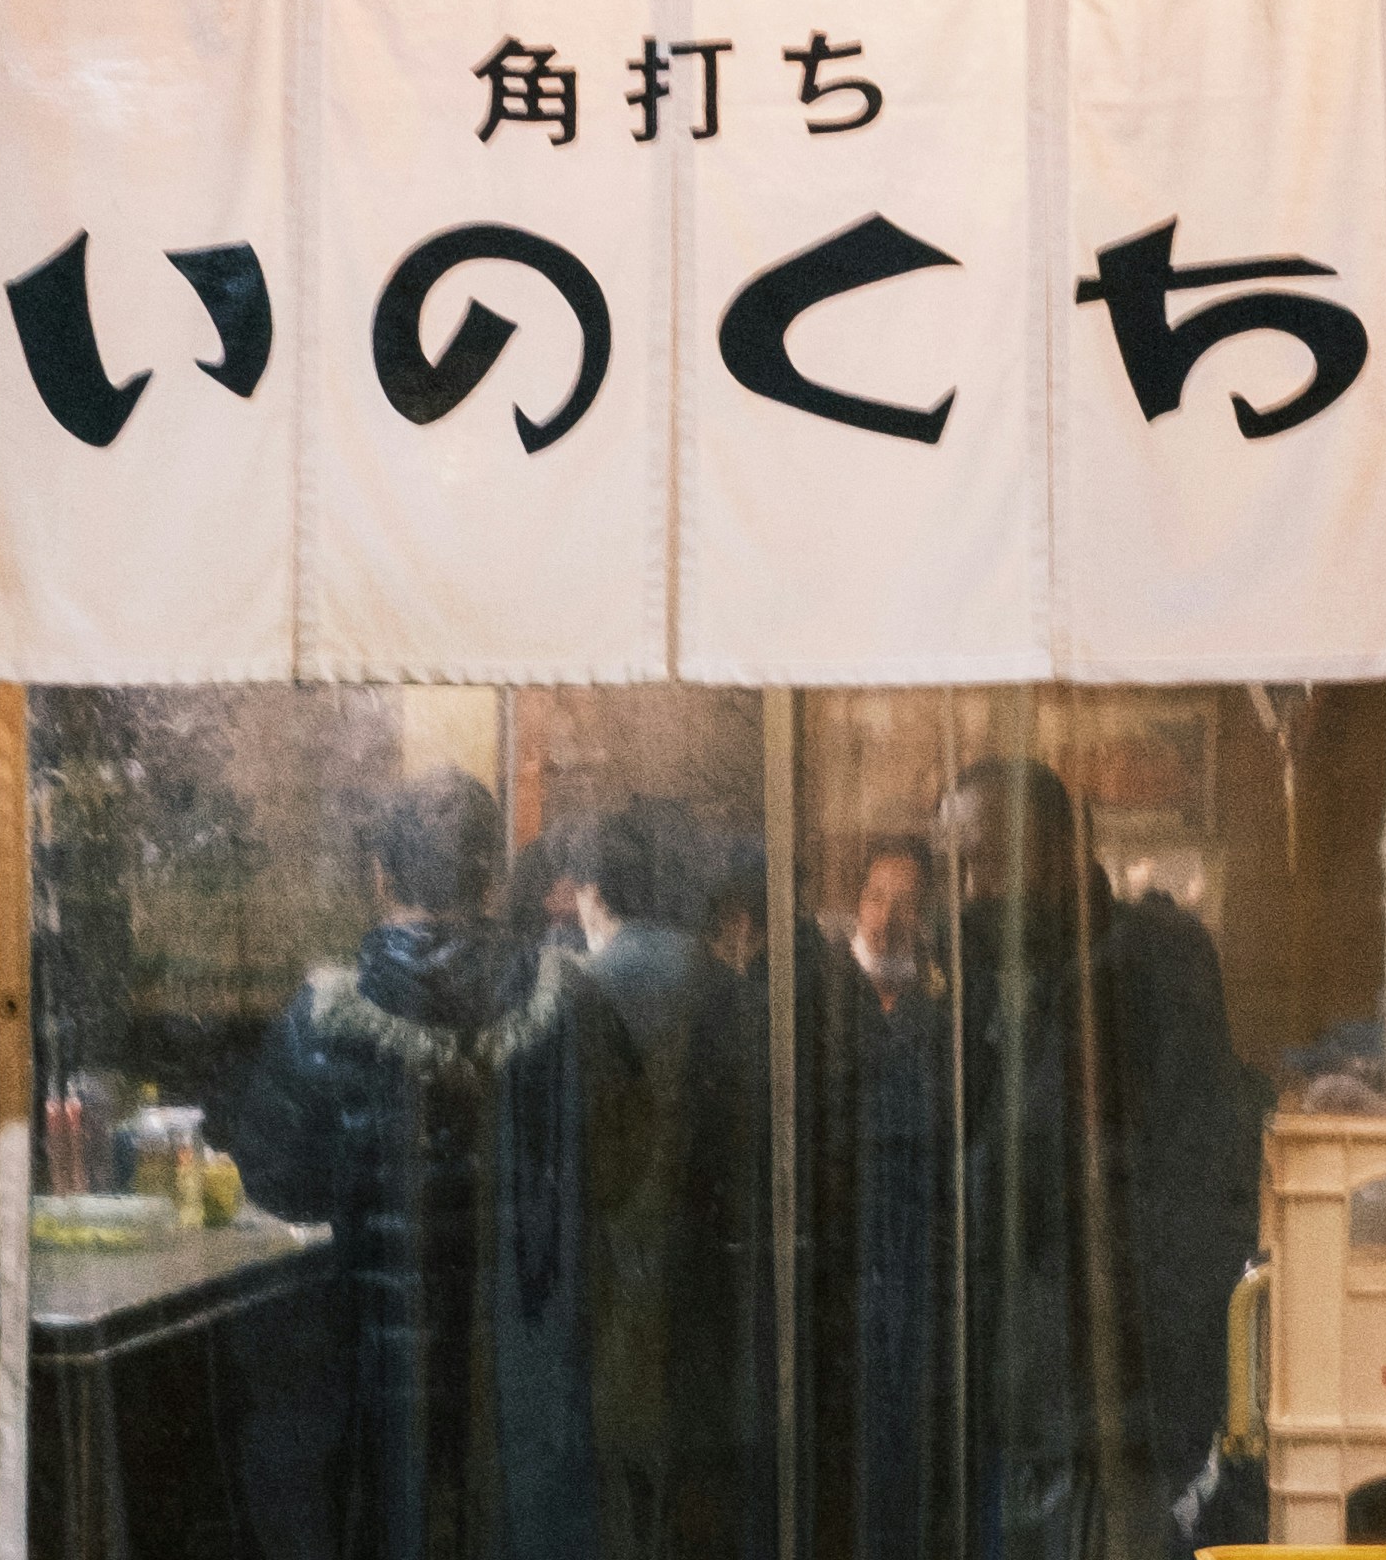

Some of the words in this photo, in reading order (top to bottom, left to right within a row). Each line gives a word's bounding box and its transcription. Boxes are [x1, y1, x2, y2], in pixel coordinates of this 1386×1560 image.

[472, 30, 885, 147] 角打ち
[4, 212, 1371, 455] いのくち
